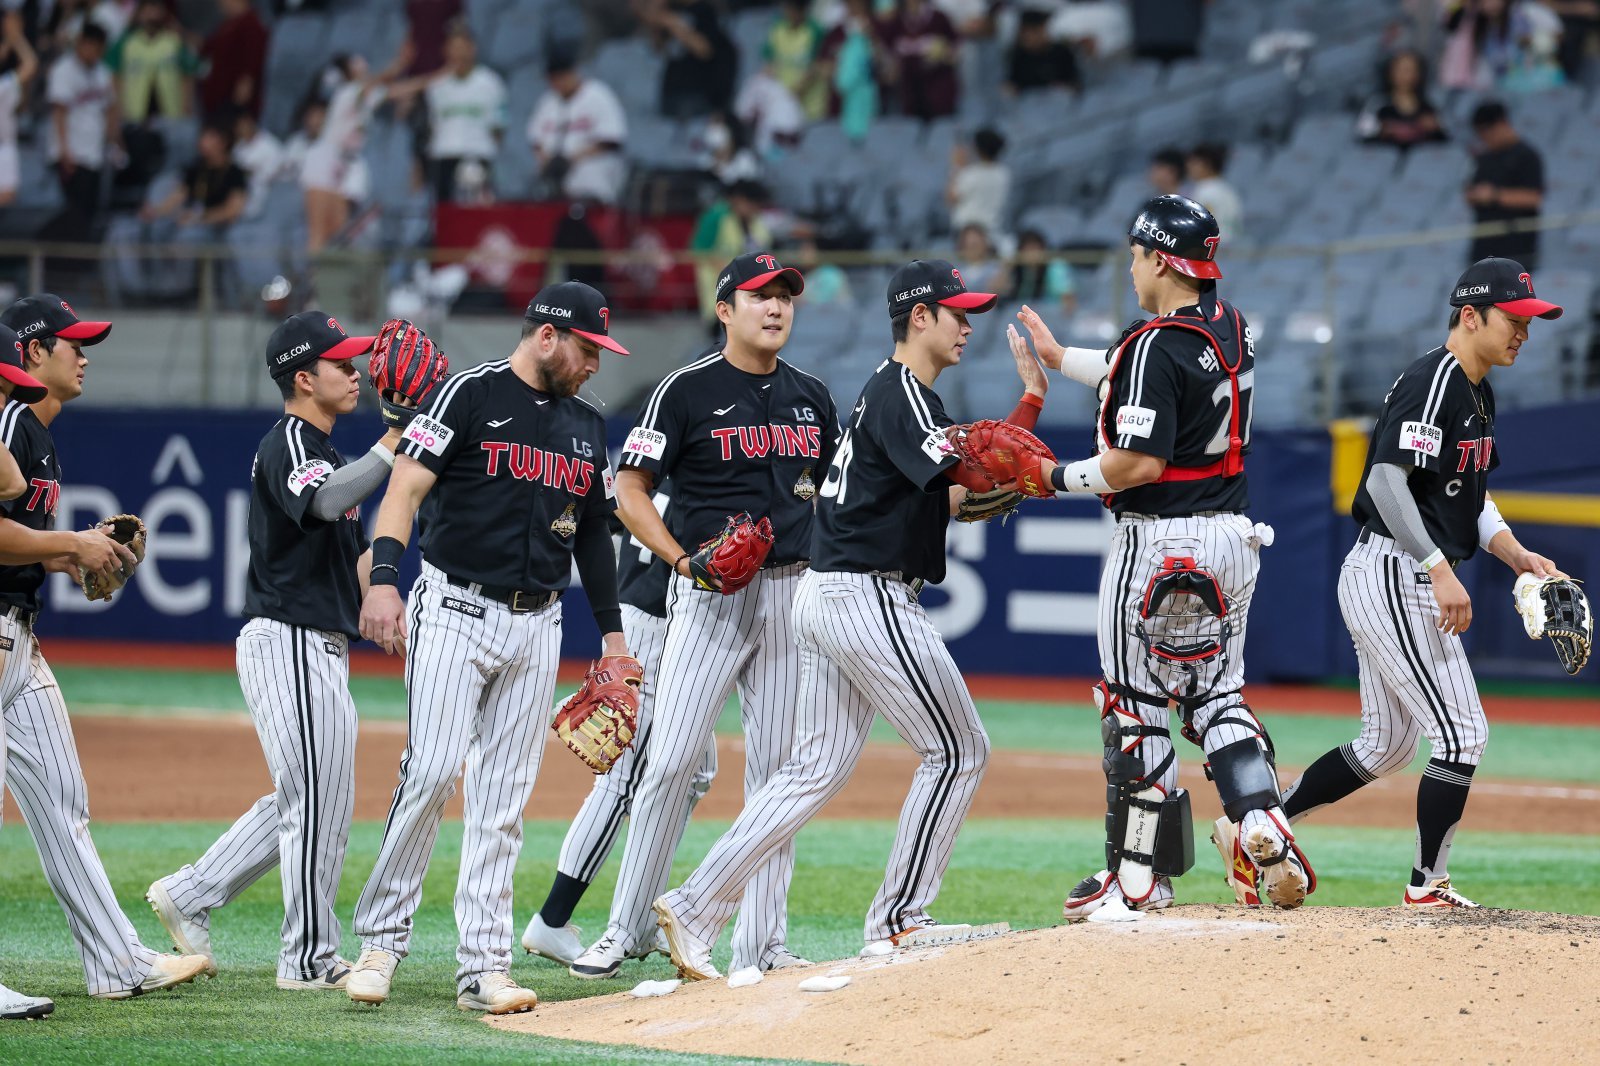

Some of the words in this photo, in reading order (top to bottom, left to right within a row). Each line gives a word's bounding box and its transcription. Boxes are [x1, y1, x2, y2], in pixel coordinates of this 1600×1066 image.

[895, 284, 932, 302] LGE.COM
[1456, 285, 1489, 297] LGE.COM
[535, 303, 572, 318] LGE.COM
[276, 342, 311, 365] LGE.COM
[792, 408, 815, 421] LG
[1204, 368, 1255, 455] 27
[1406, 425, 1417, 433] AI
[572, 437, 594, 457] LG
[711, 423, 820, 460] TWINS
[481, 441, 594, 496] TWINS
[1445, 479, 1463, 497] C
